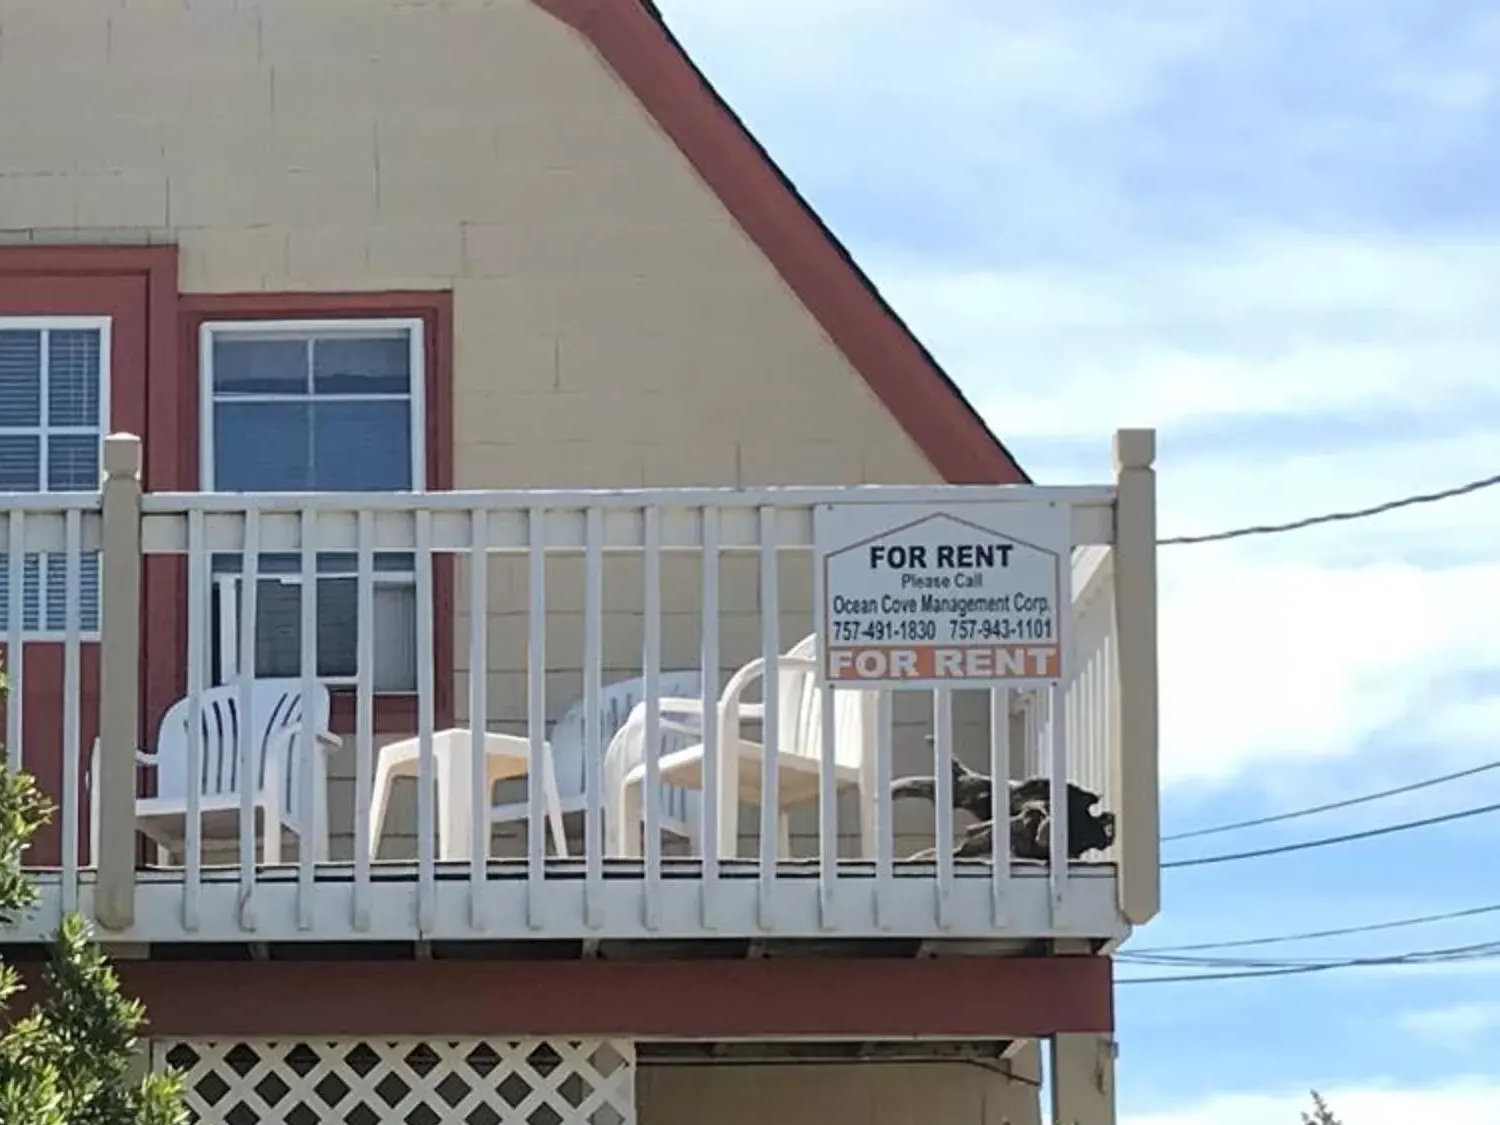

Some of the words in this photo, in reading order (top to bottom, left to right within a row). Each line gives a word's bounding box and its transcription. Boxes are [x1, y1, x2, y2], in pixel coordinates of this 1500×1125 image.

[870, 546, 927, 569] FOR
[937, 545, 1013, 568] RENT
[901, 573, 950, 589] Please
[954, 573, 982, 588] Call
[833, 595, 878, 614] Ocean
[881, 595, 917, 613] Cove
[921, 594, 1010, 617] Management
[833, 620, 937, 641] 757-491-1830
[950, 619, 1052, 639] 757-943-1101
[829, 650, 919, 677] FOR
[934, 649, 1056, 676] RENT
